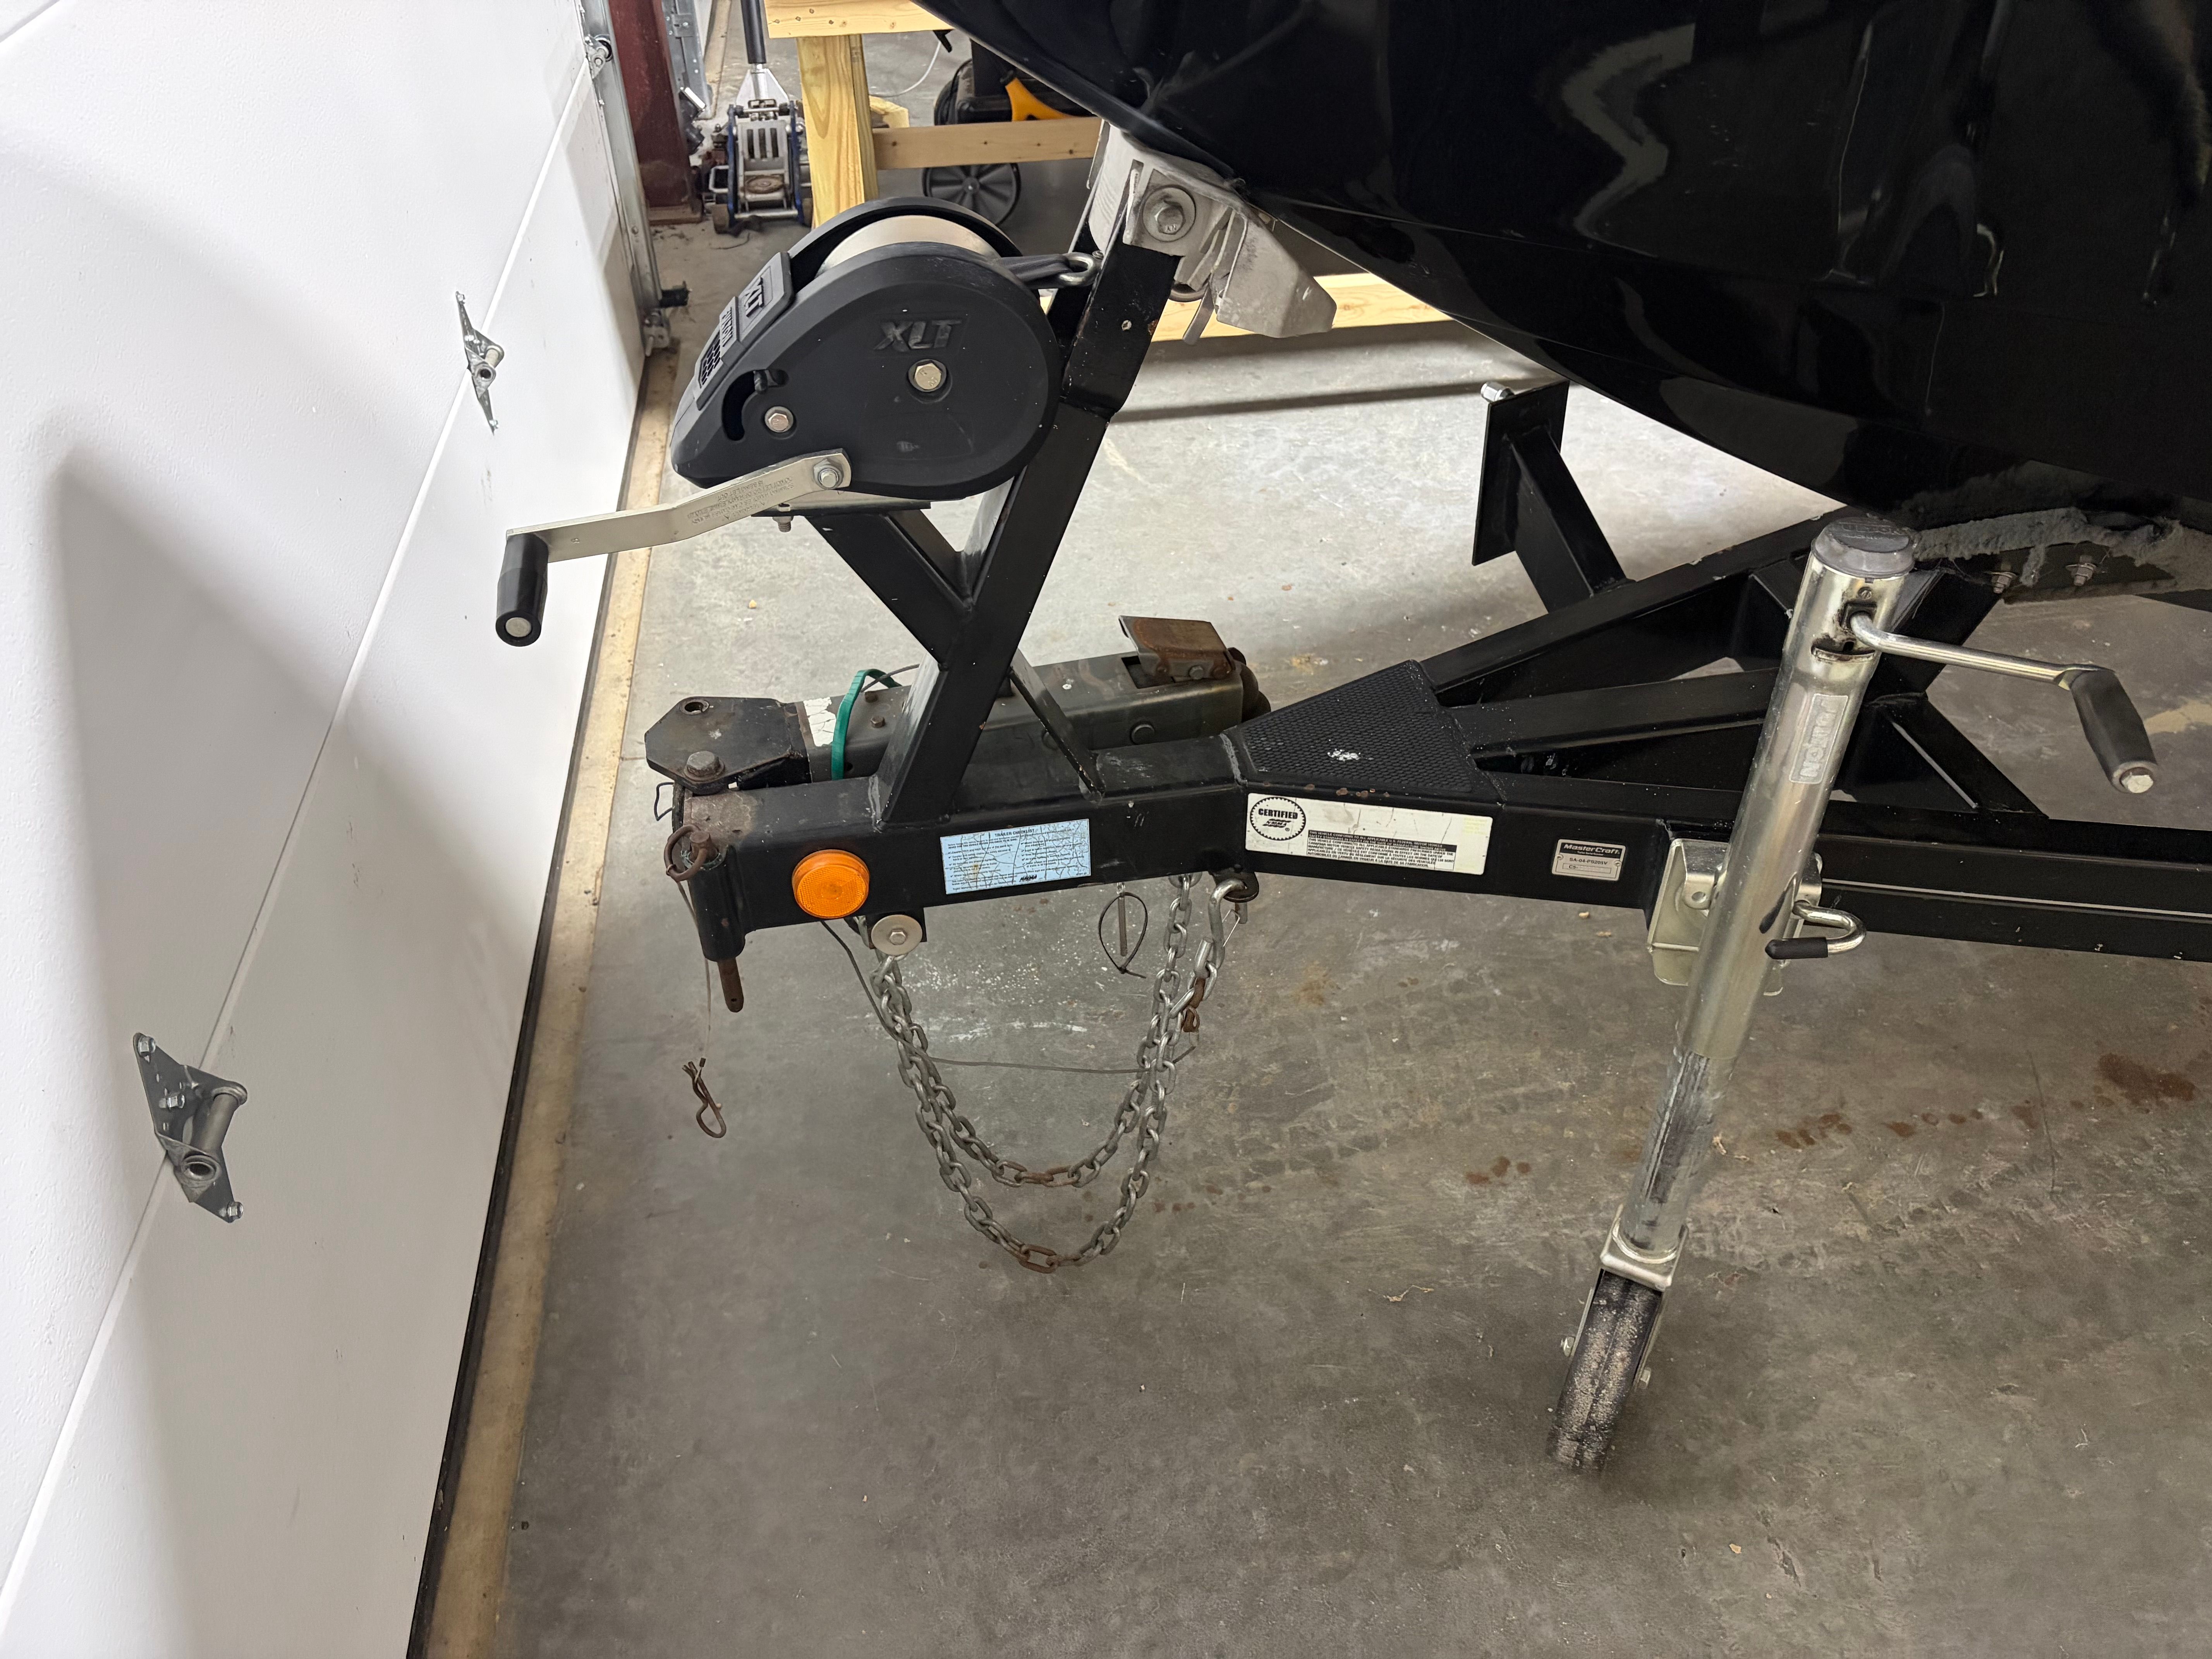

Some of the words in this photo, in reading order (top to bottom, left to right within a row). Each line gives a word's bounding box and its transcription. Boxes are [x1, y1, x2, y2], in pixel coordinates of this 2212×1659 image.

[873, 319, 962, 352] XLT
[1259, 809, 1298, 819] CERTIFIED
[1563, 843, 1618, 854] MasterCraft
